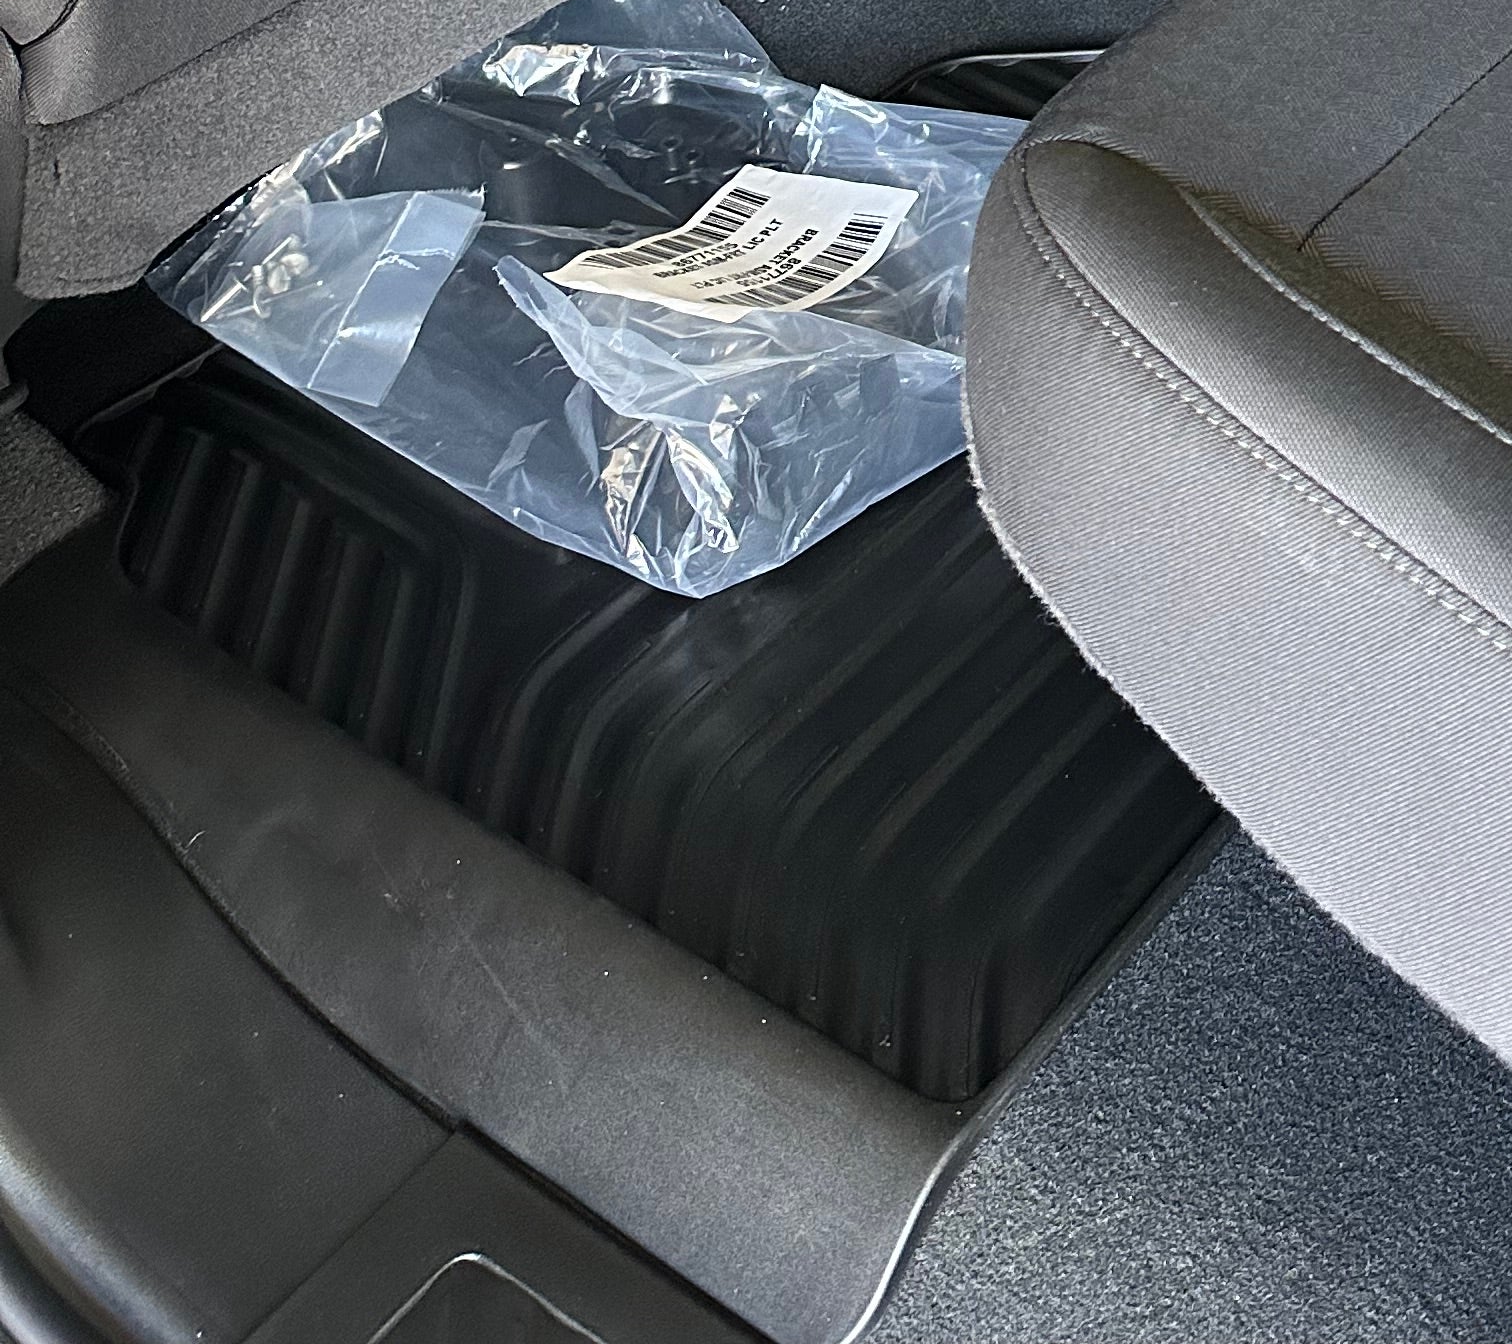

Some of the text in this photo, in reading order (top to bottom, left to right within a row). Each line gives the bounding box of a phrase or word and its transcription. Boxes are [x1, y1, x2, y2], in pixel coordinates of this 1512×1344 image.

[742, 236, 765, 250] LIC
[759, 218, 784, 237] PLT
[768, 228, 820, 266] BRACKET
